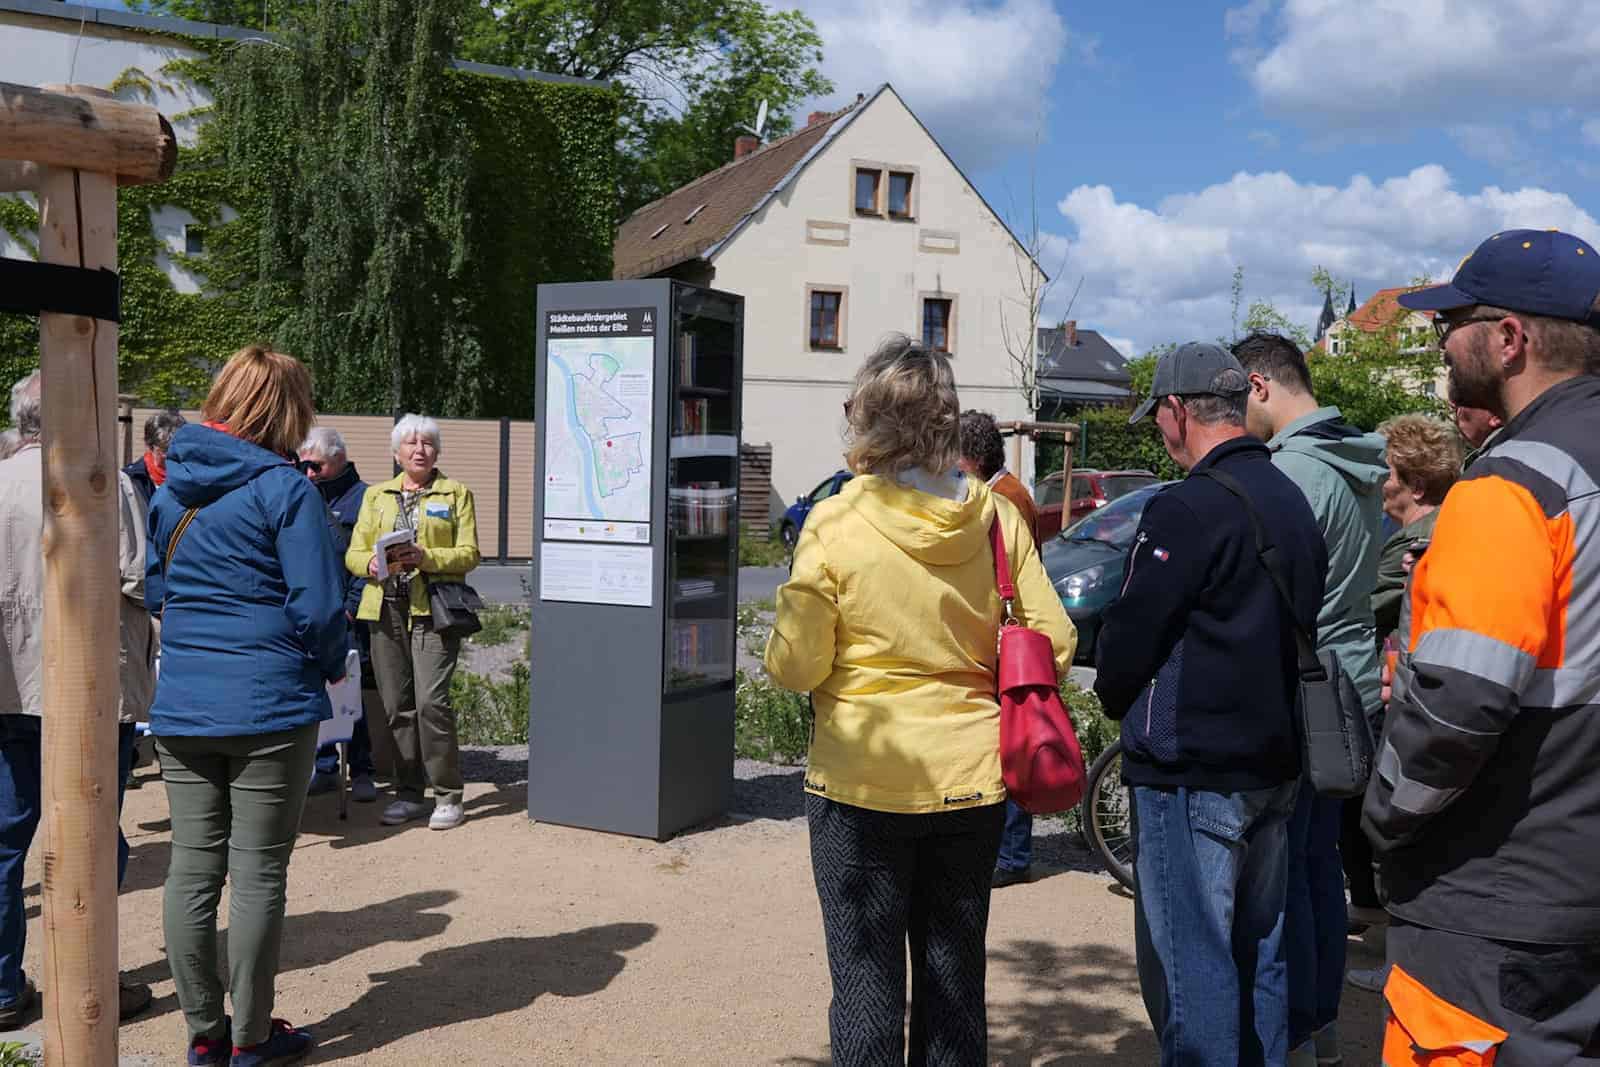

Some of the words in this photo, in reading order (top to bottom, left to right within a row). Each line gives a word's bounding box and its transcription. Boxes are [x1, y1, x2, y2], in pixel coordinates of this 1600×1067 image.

[550, 312, 627, 322] Städtebaufördergebiet
[550, 324, 575, 333] Meißen
[577, 324, 597, 333] rechts
[599, 323, 611, 332] der
[612, 323, 628, 332] Elbe
